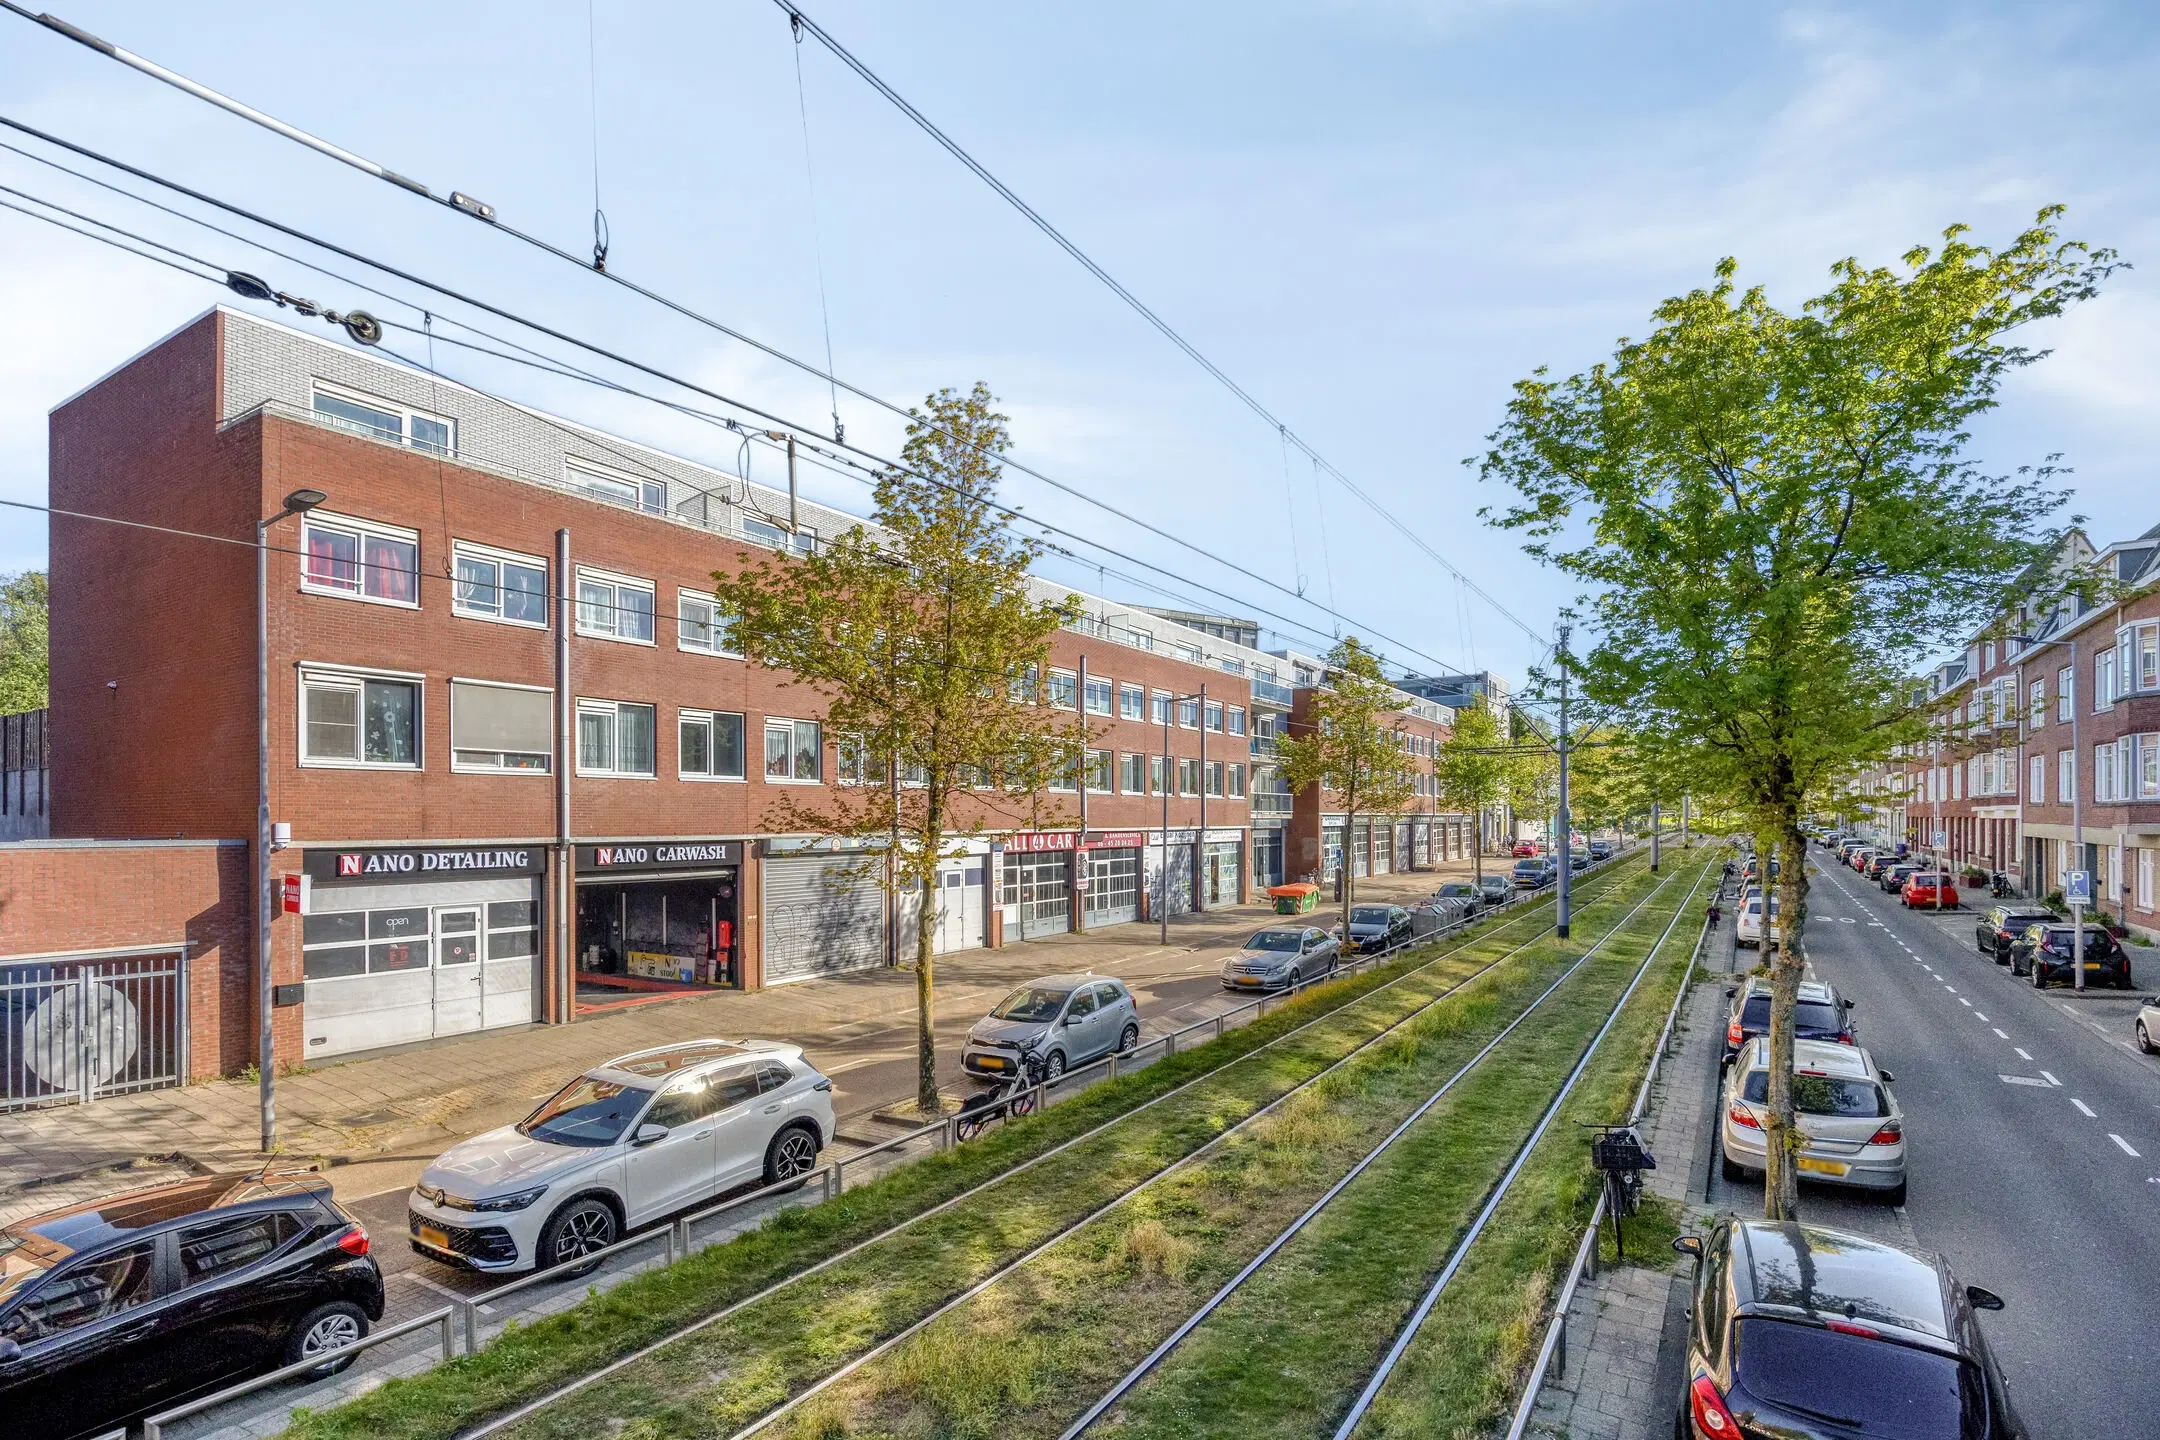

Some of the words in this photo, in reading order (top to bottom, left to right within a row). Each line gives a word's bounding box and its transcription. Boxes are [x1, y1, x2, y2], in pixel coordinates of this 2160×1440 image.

[1003, 835, 1028, 851] ALL
[1047, 834, 1073, 849] CAR
[341, 854, 415, 874] NANO
[422, 851, 529, 870] DETAILING
[599, 848, 648, 864] NANO
[656, 846, 726, 861] CARWASH
[2071, 872, 2084, 886] P
[386, 917, 409, 930] open
